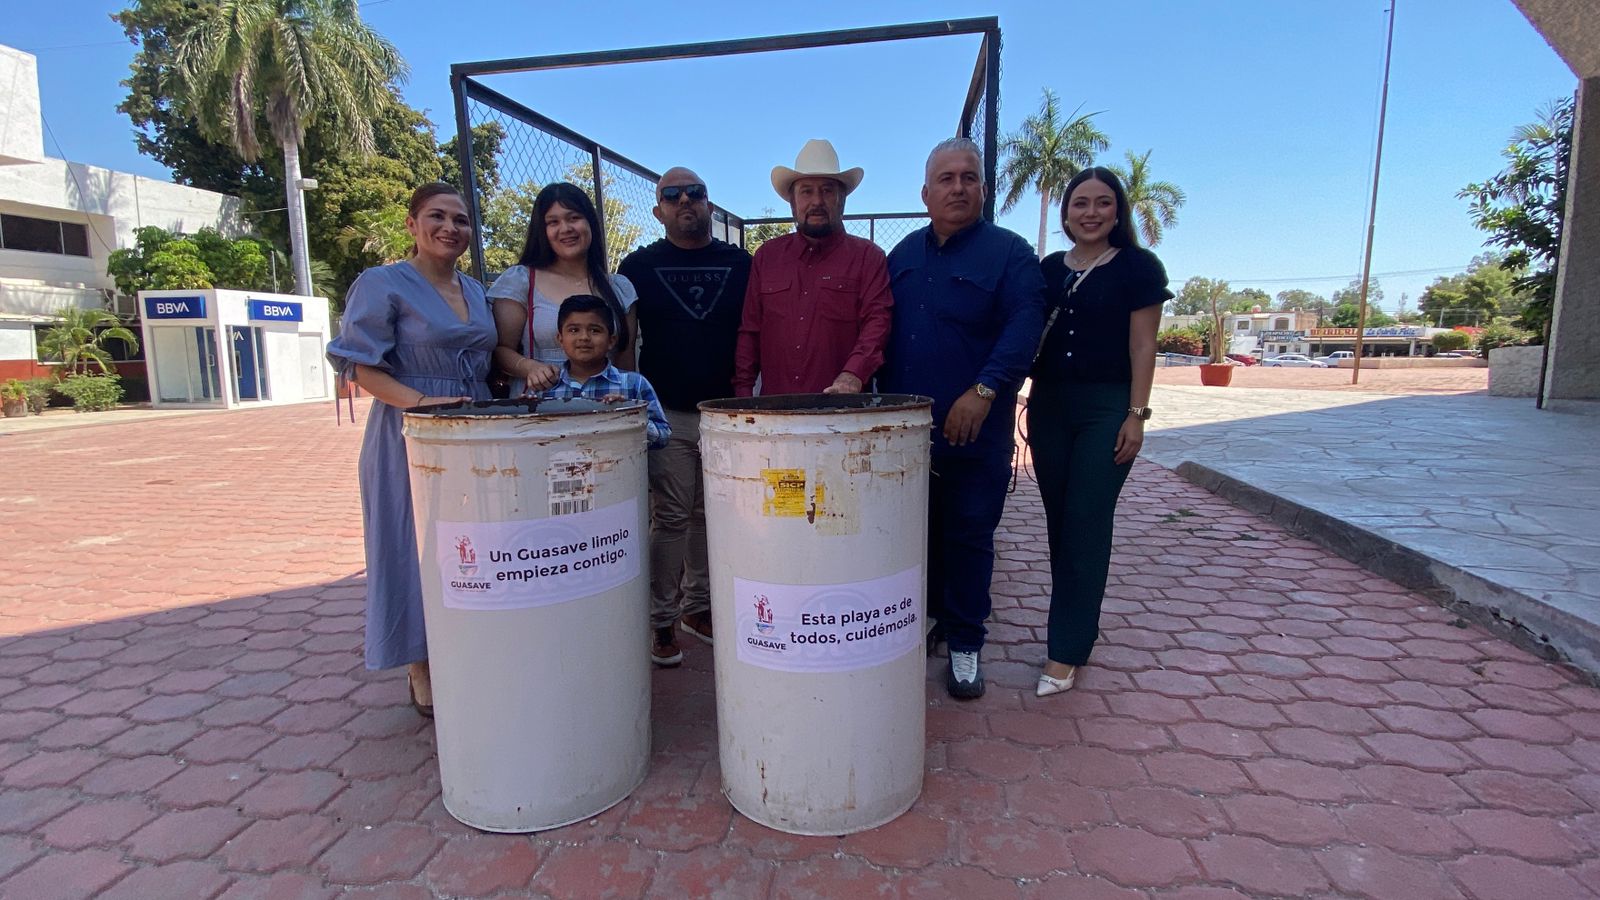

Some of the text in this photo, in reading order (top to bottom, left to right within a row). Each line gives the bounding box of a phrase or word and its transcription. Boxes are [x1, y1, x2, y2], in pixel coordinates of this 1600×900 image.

[156, 302, 190, 314] BBVA
[264, 305, 293, 317] BBVA
[489, 528, 629, 563] Un Guasave limpio
[496, 549, 628, 582] empieza contigo.
[451, 581, 492, 590] GUASAVE
[801, 596, 912, 627] Esta playa es de
[790, 612, 918, 645] todos, cuidémosla.
[747, 637, 786, 650] GUASAVE
